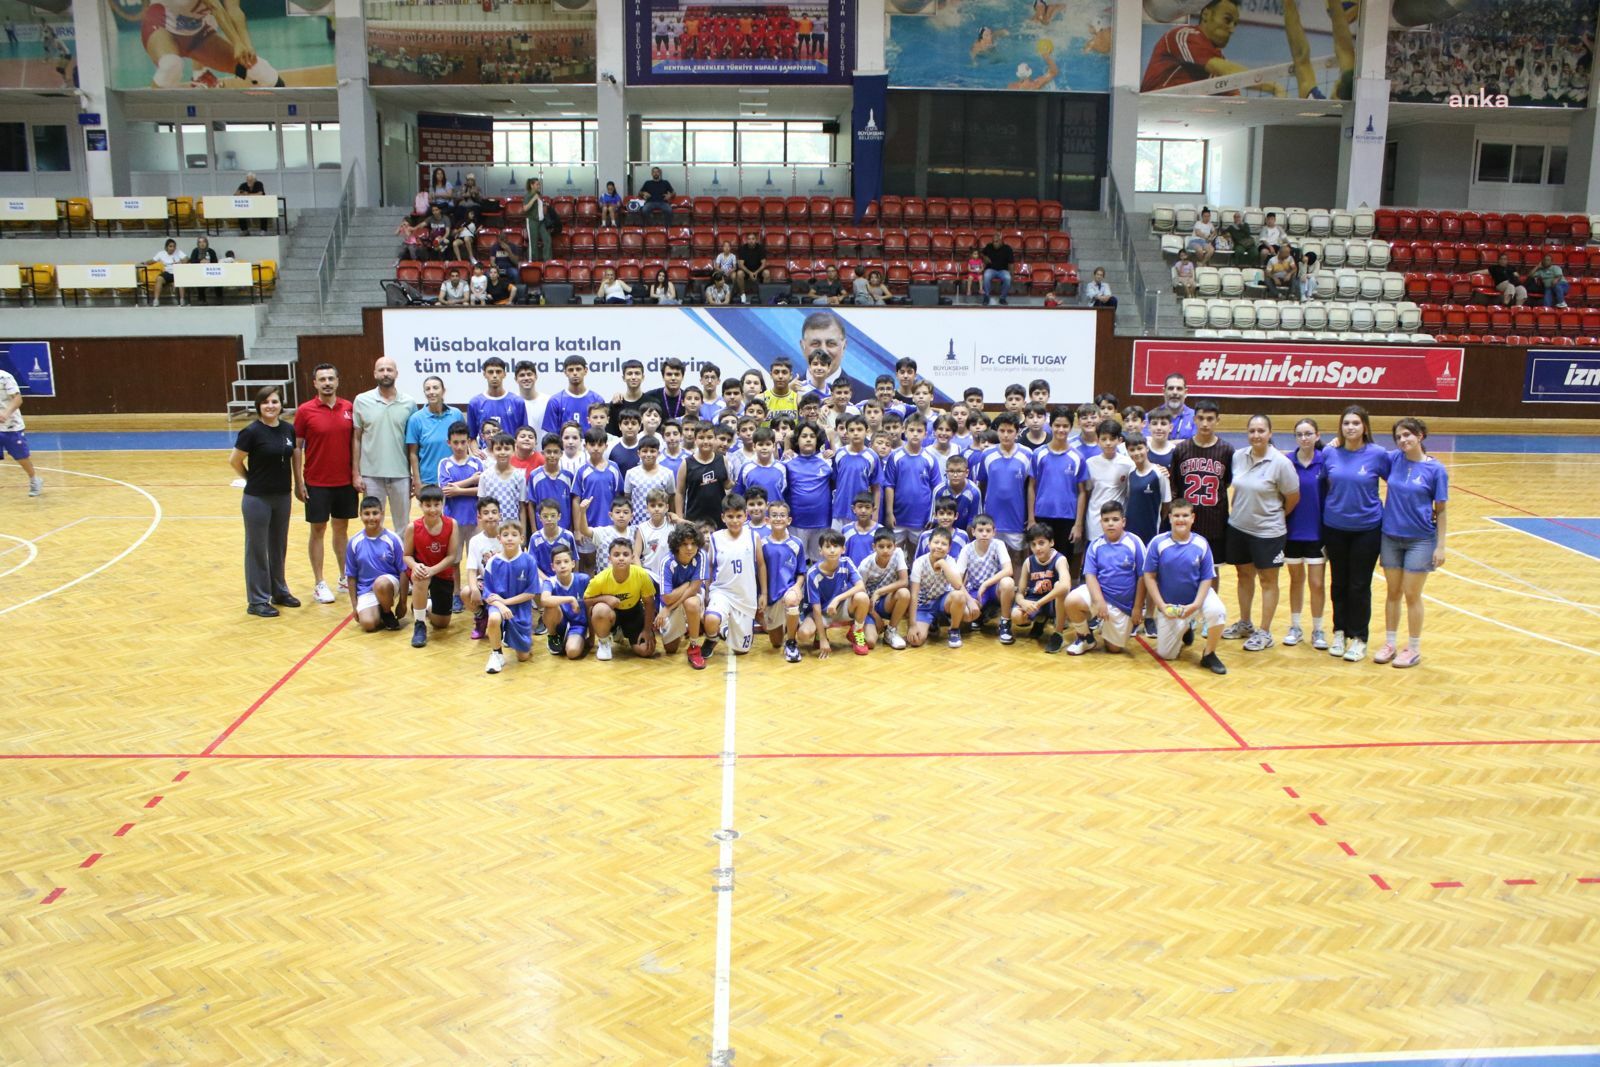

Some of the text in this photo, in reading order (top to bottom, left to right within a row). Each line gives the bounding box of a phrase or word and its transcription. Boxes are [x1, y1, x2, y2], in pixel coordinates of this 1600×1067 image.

[1214, 80, 1229, 89] CEV
[413, 336, 621, 352] Müsabakalara katılan
[414, 358, 451, 373] tüm
[980, 353, 1067, 364] Dr. CEMİL TUGAY
[1196, 353, 1386, 388] #İzmirİçinSpor
[1184, 474, 1219, 506] 23
[731, 559, 743, 574] 19
